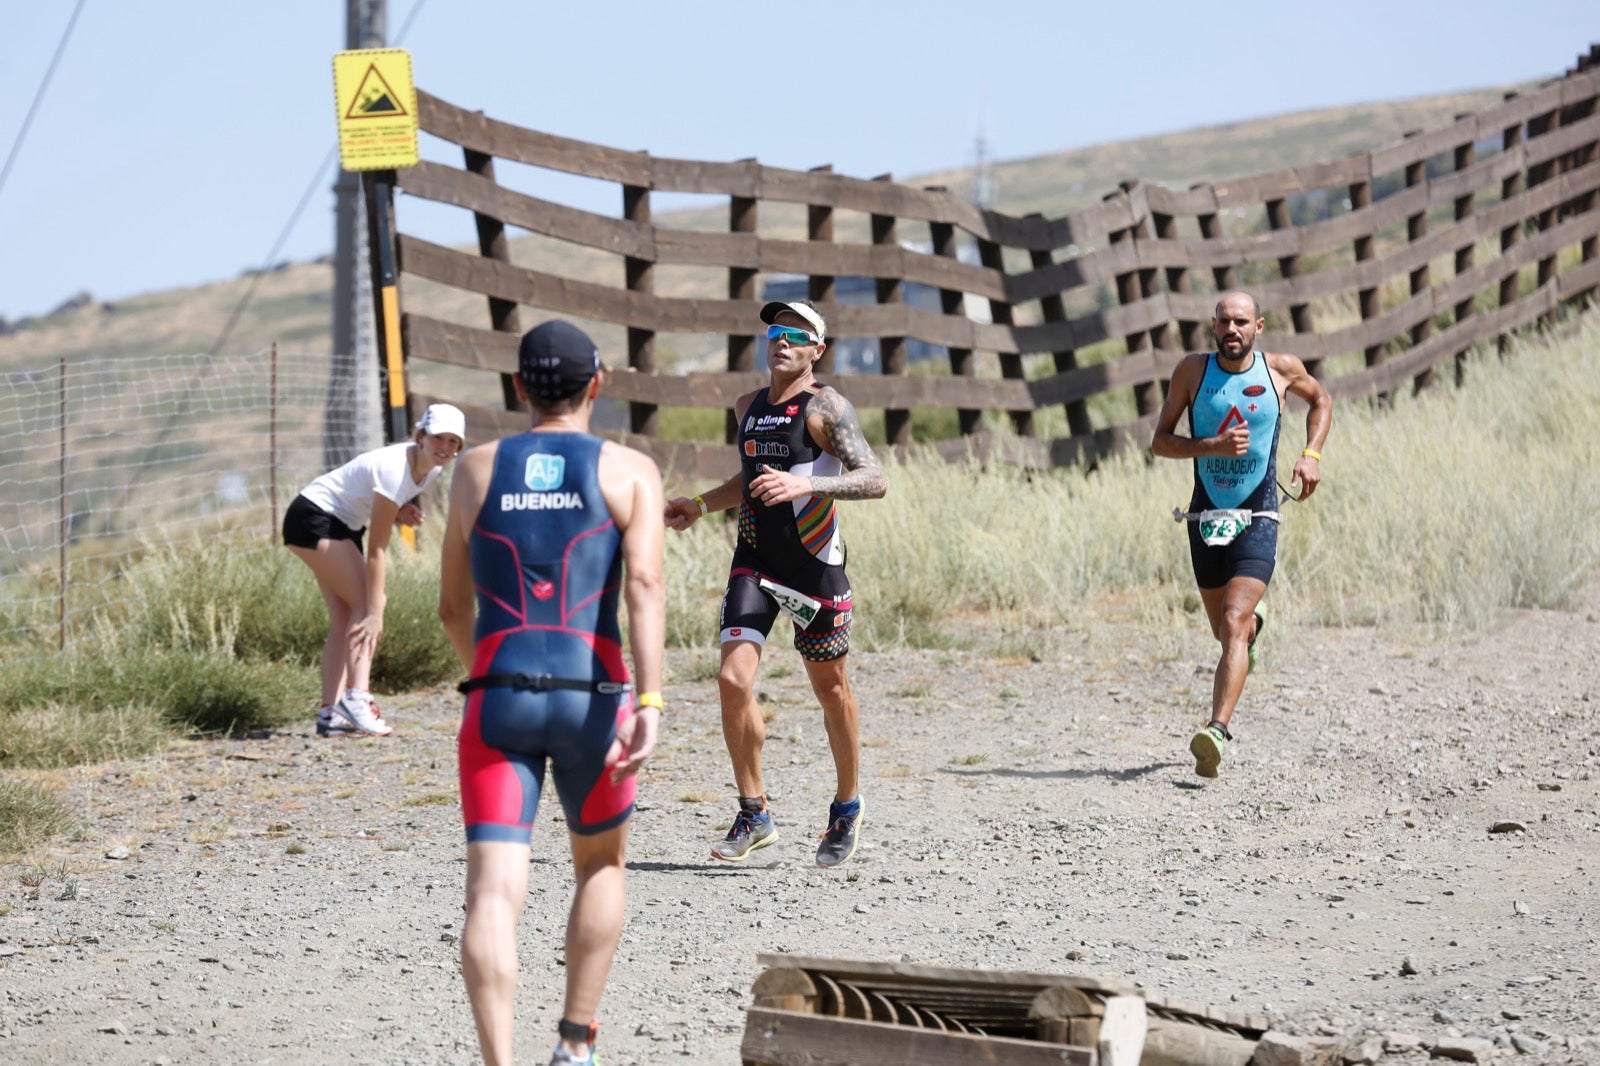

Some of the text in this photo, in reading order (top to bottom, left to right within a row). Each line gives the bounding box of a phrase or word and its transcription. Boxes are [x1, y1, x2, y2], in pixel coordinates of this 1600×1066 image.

[757, 415, 792, 426] olimpo
[755, 462, 782, 473] IGCIO
[1206, 458, 1257, 474] ALBALADEJO
[501, 492, 584, 511] BUENDIA
[1211, 519, 1237, 537] 73
